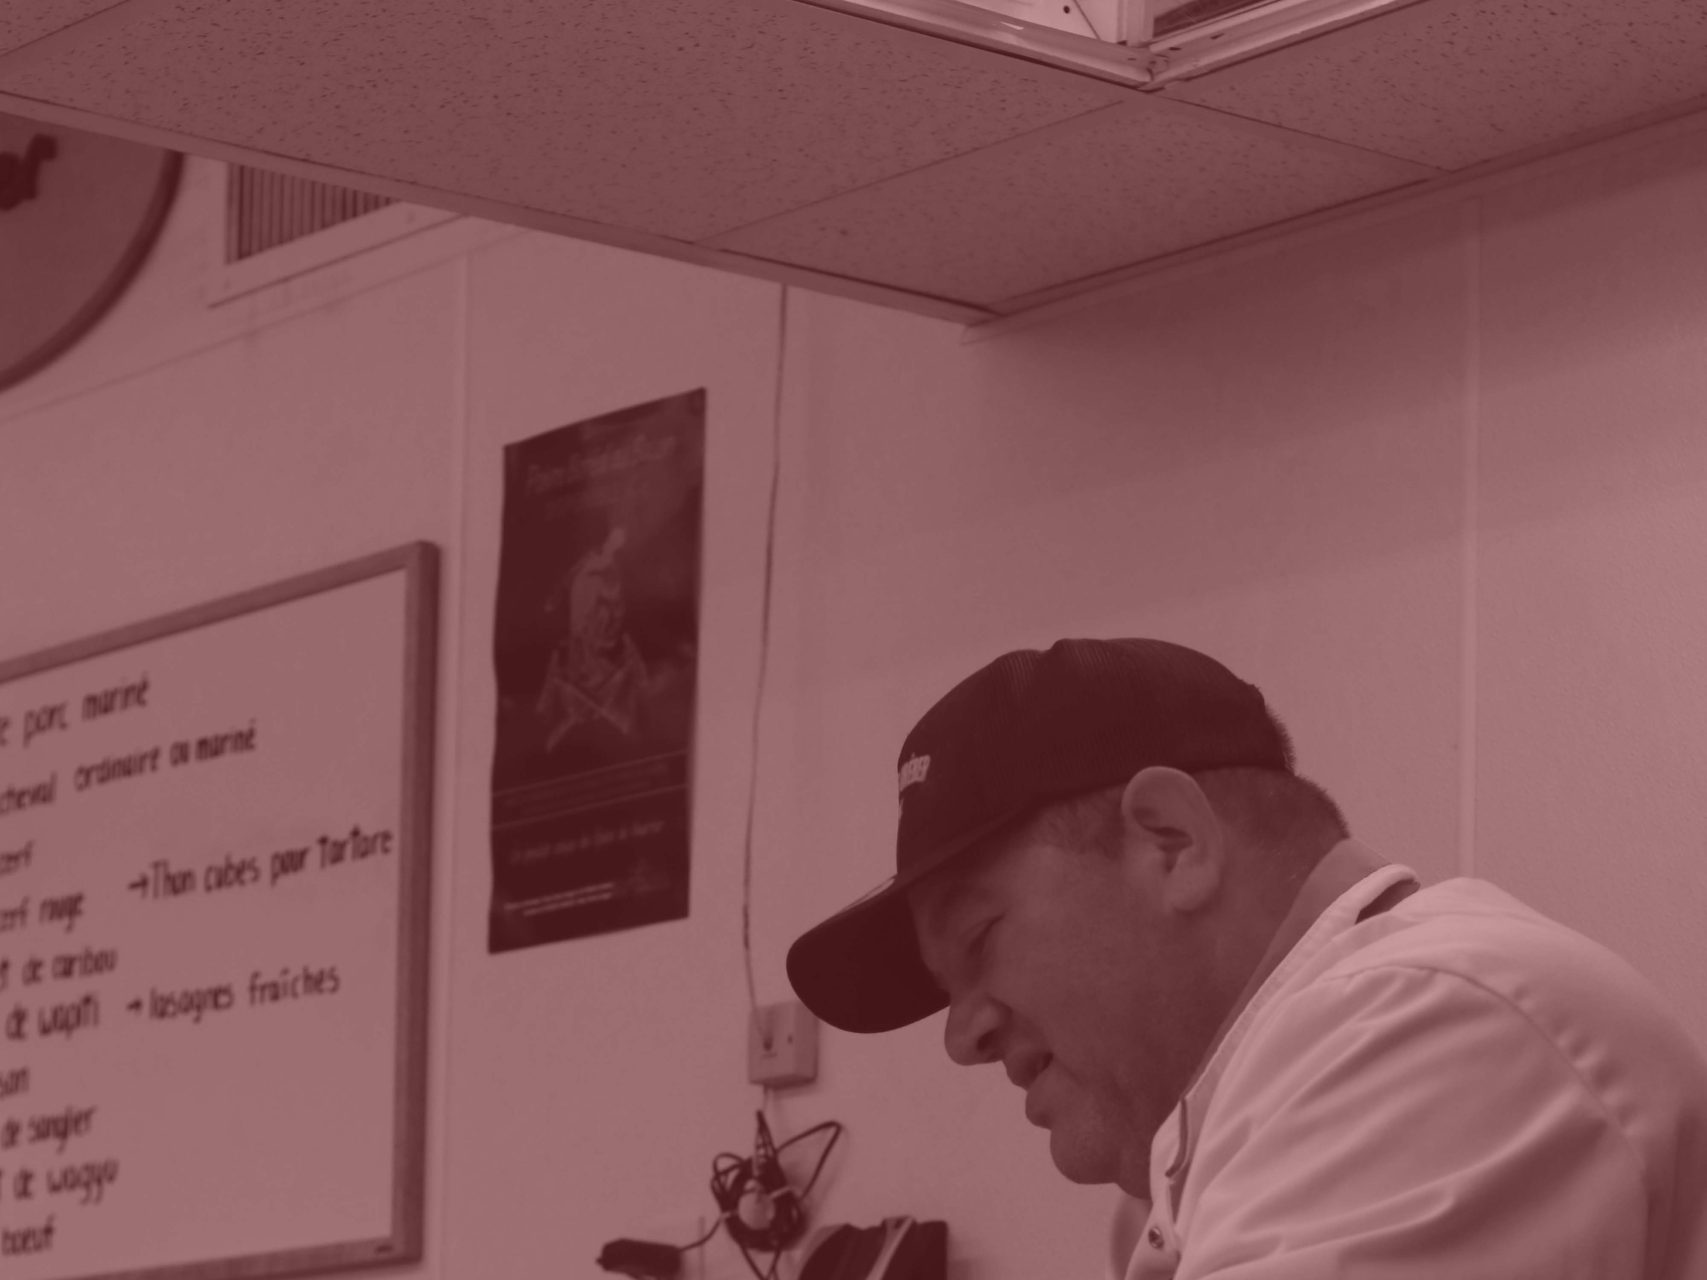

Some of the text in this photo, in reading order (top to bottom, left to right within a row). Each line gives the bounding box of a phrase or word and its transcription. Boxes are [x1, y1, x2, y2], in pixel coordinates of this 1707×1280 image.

[23, 702, 68, 747] porc
[169, 740, 192, 768] ou
[150, 859, 196, 899] Thon
[203, 854, 261, 894] cubes
[270, 846, 311, 887] pour
